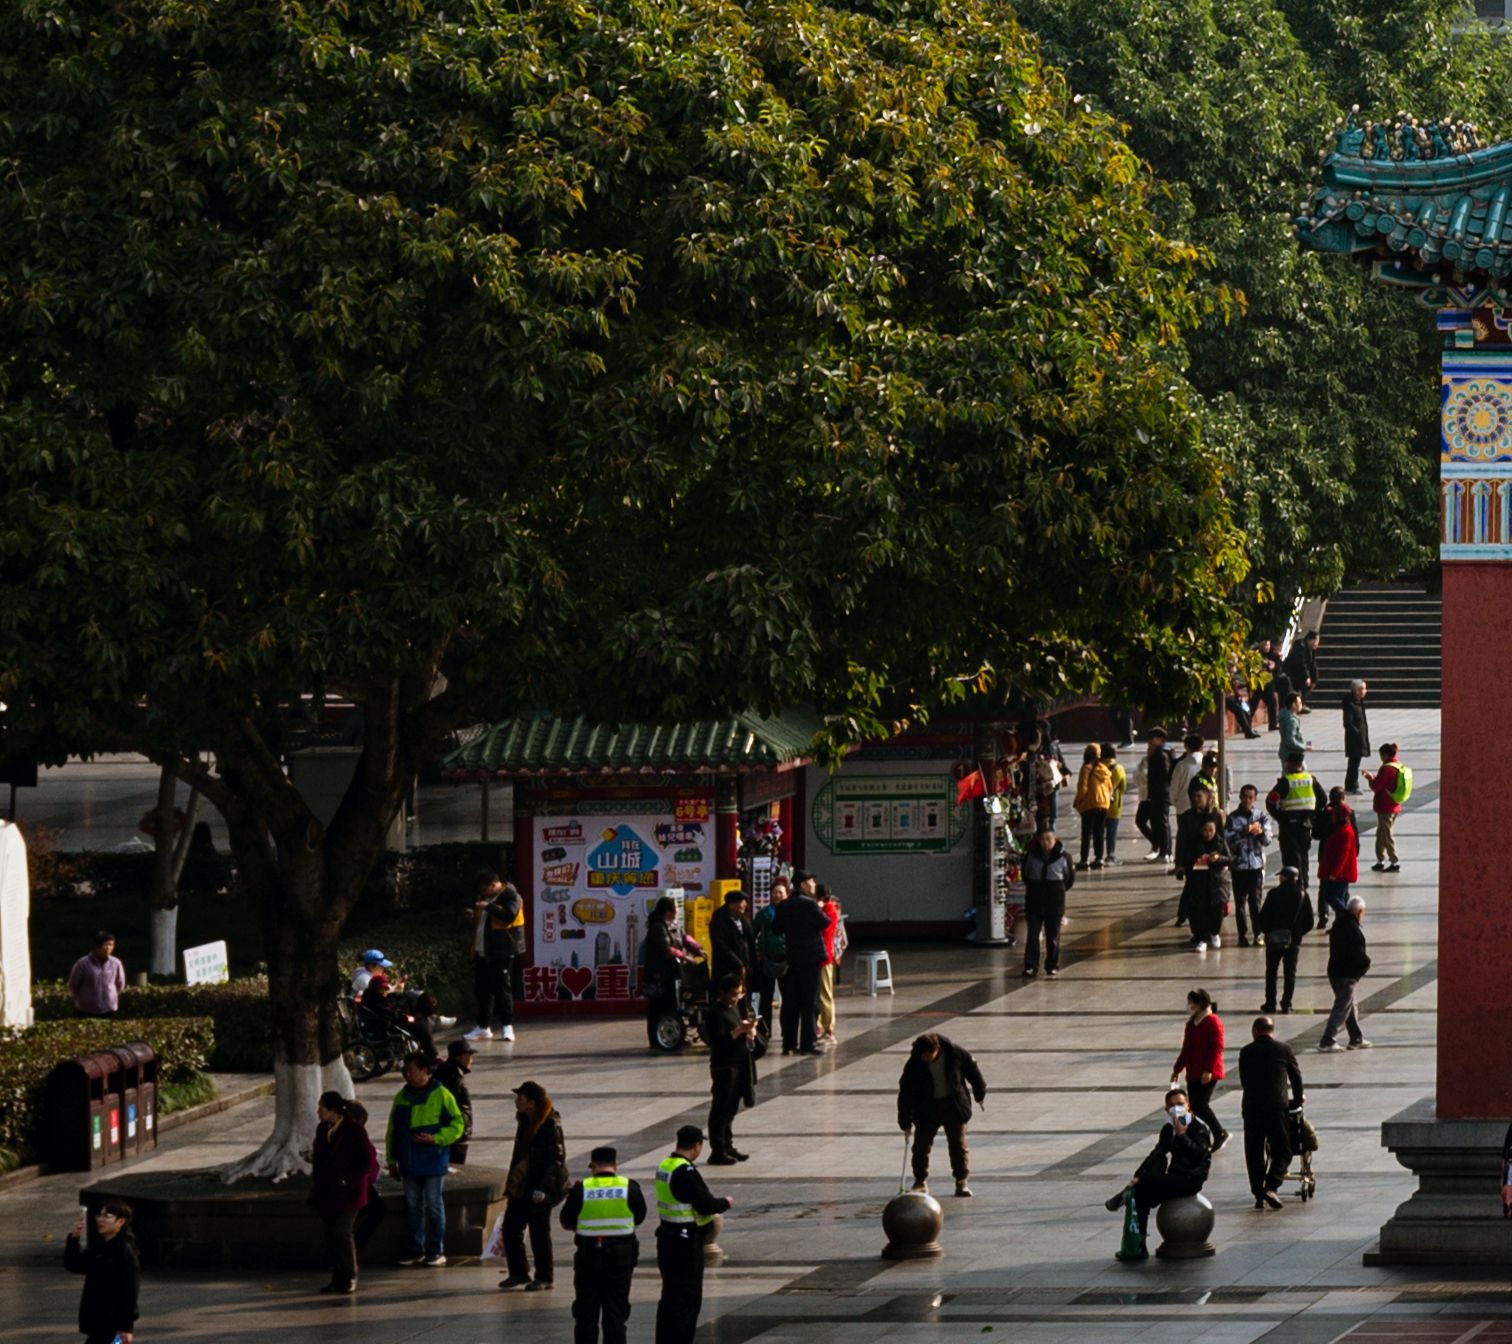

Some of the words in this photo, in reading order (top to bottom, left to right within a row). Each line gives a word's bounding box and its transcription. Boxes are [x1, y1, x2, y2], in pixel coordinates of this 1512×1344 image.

[675, 805, 709, 818] 6号亭
[597, 852, 641, 869] 山城
[523, 966, 558, 1000] 我
